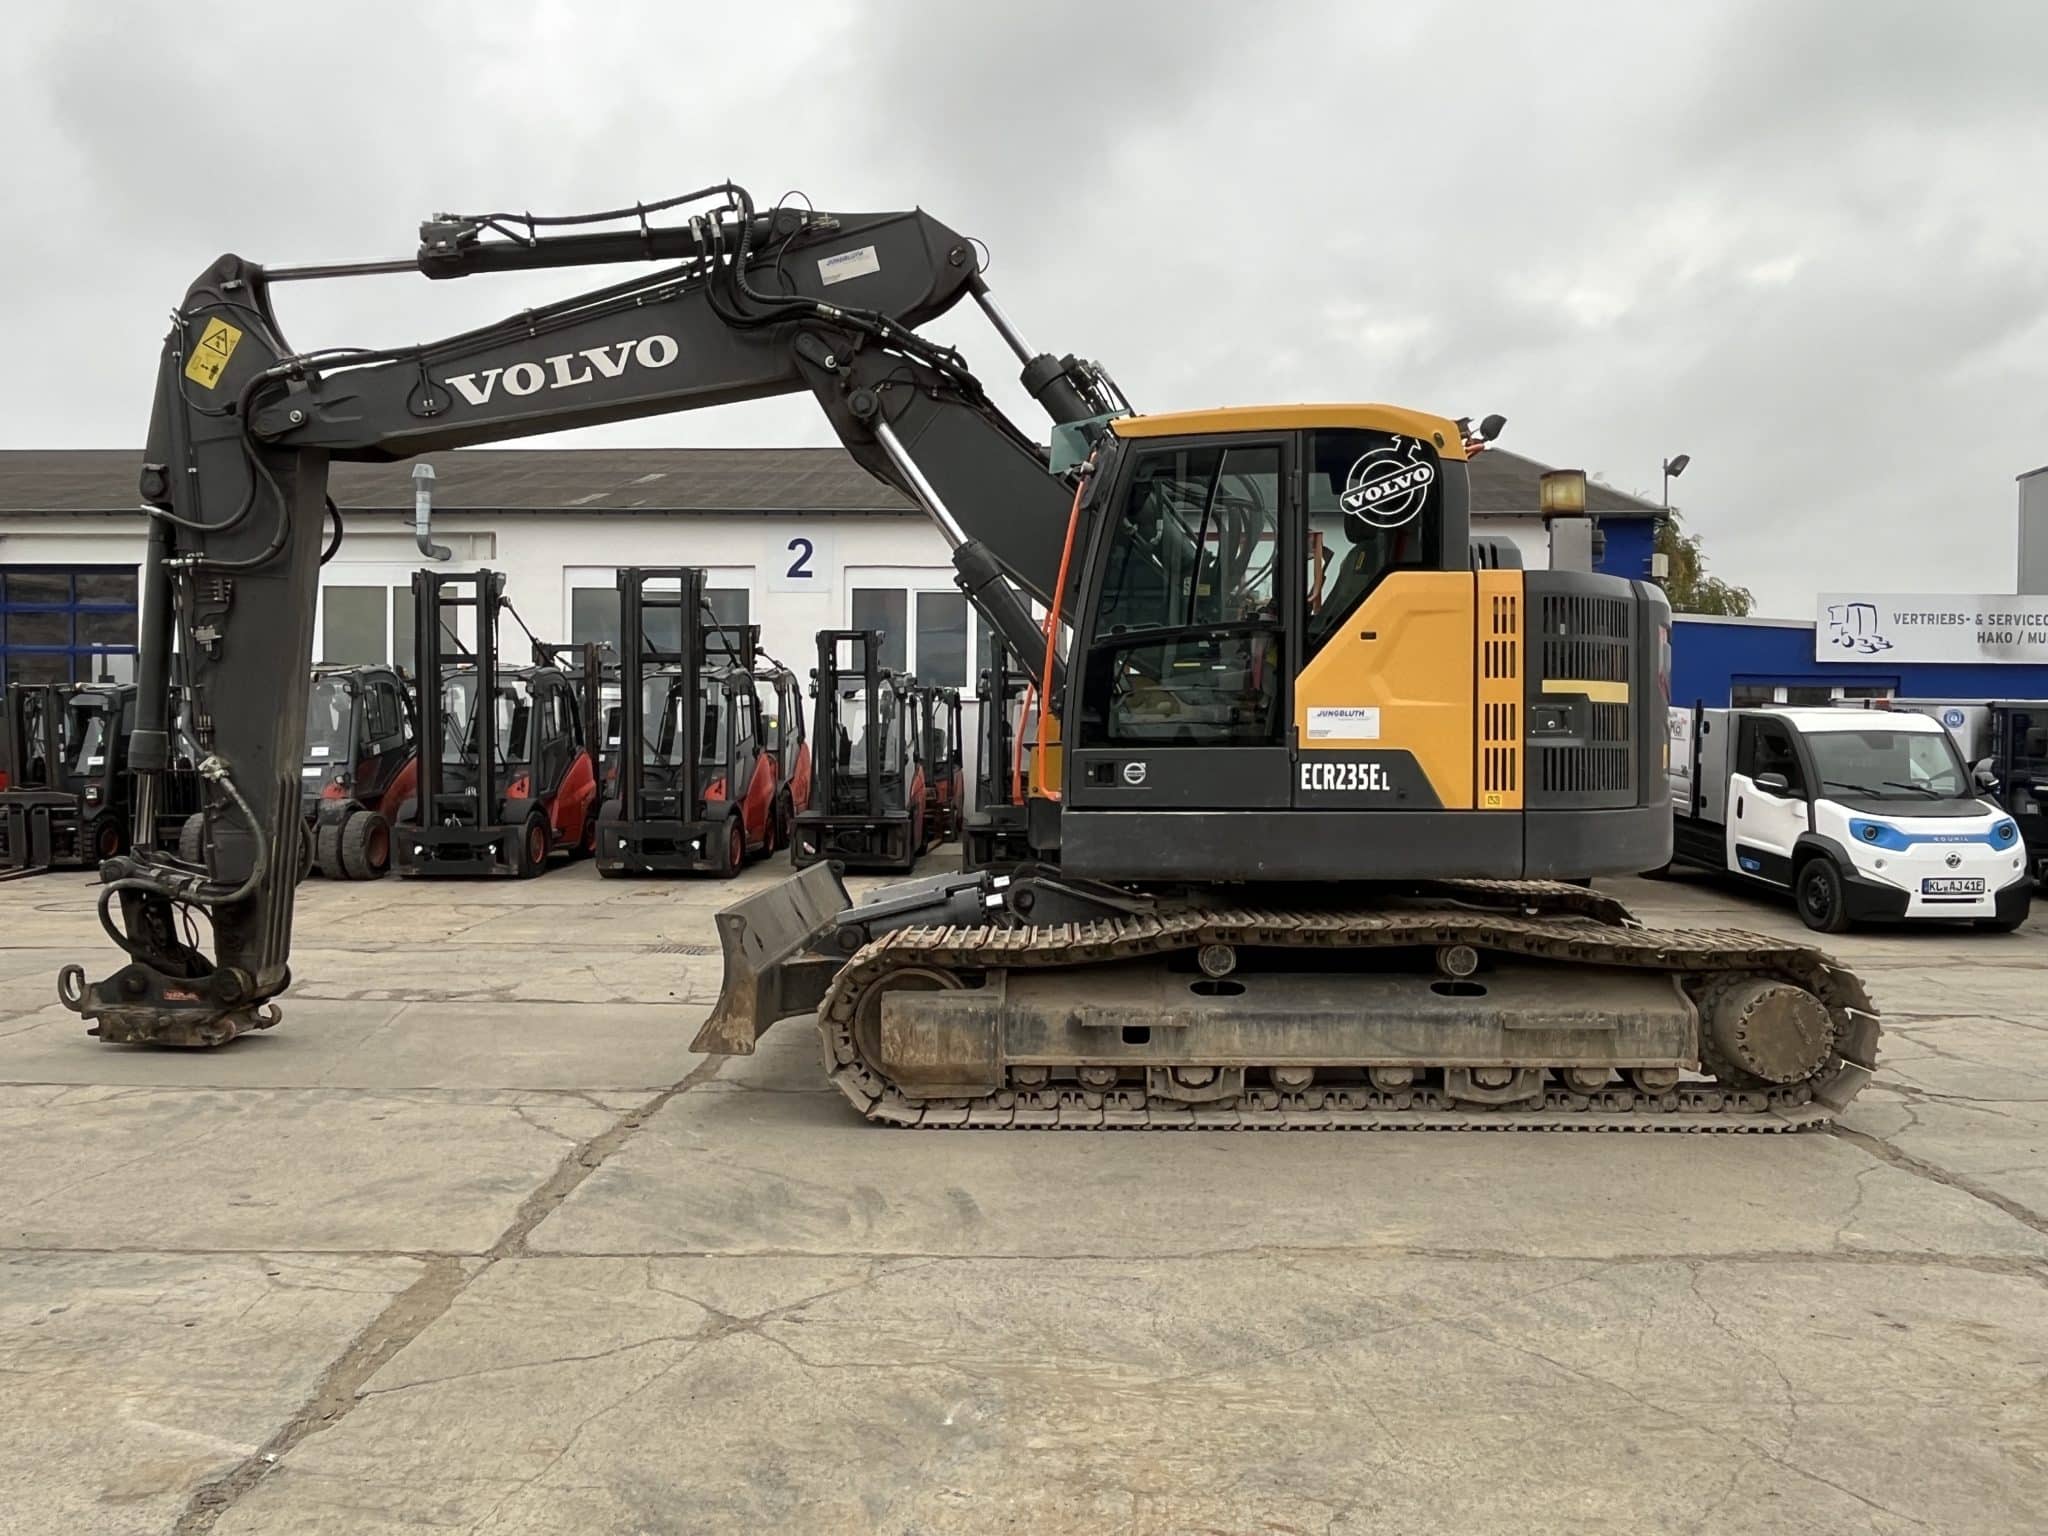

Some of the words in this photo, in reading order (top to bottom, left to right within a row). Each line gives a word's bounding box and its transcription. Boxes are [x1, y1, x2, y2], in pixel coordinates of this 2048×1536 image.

[445, 334, 679, 406] VOLVO
[1343, 467, 1431, 507] VOLVO
[786, 537, 814, 578] 2
[1893, 613, 1971, 625] VERTRIEBS-
[1975, 613, 1983, 625] &
[1977, 631, 2013, 644] HAKO
[2017, 629, 2024, 645] /
[2028, 631, 2047, 644] MU
